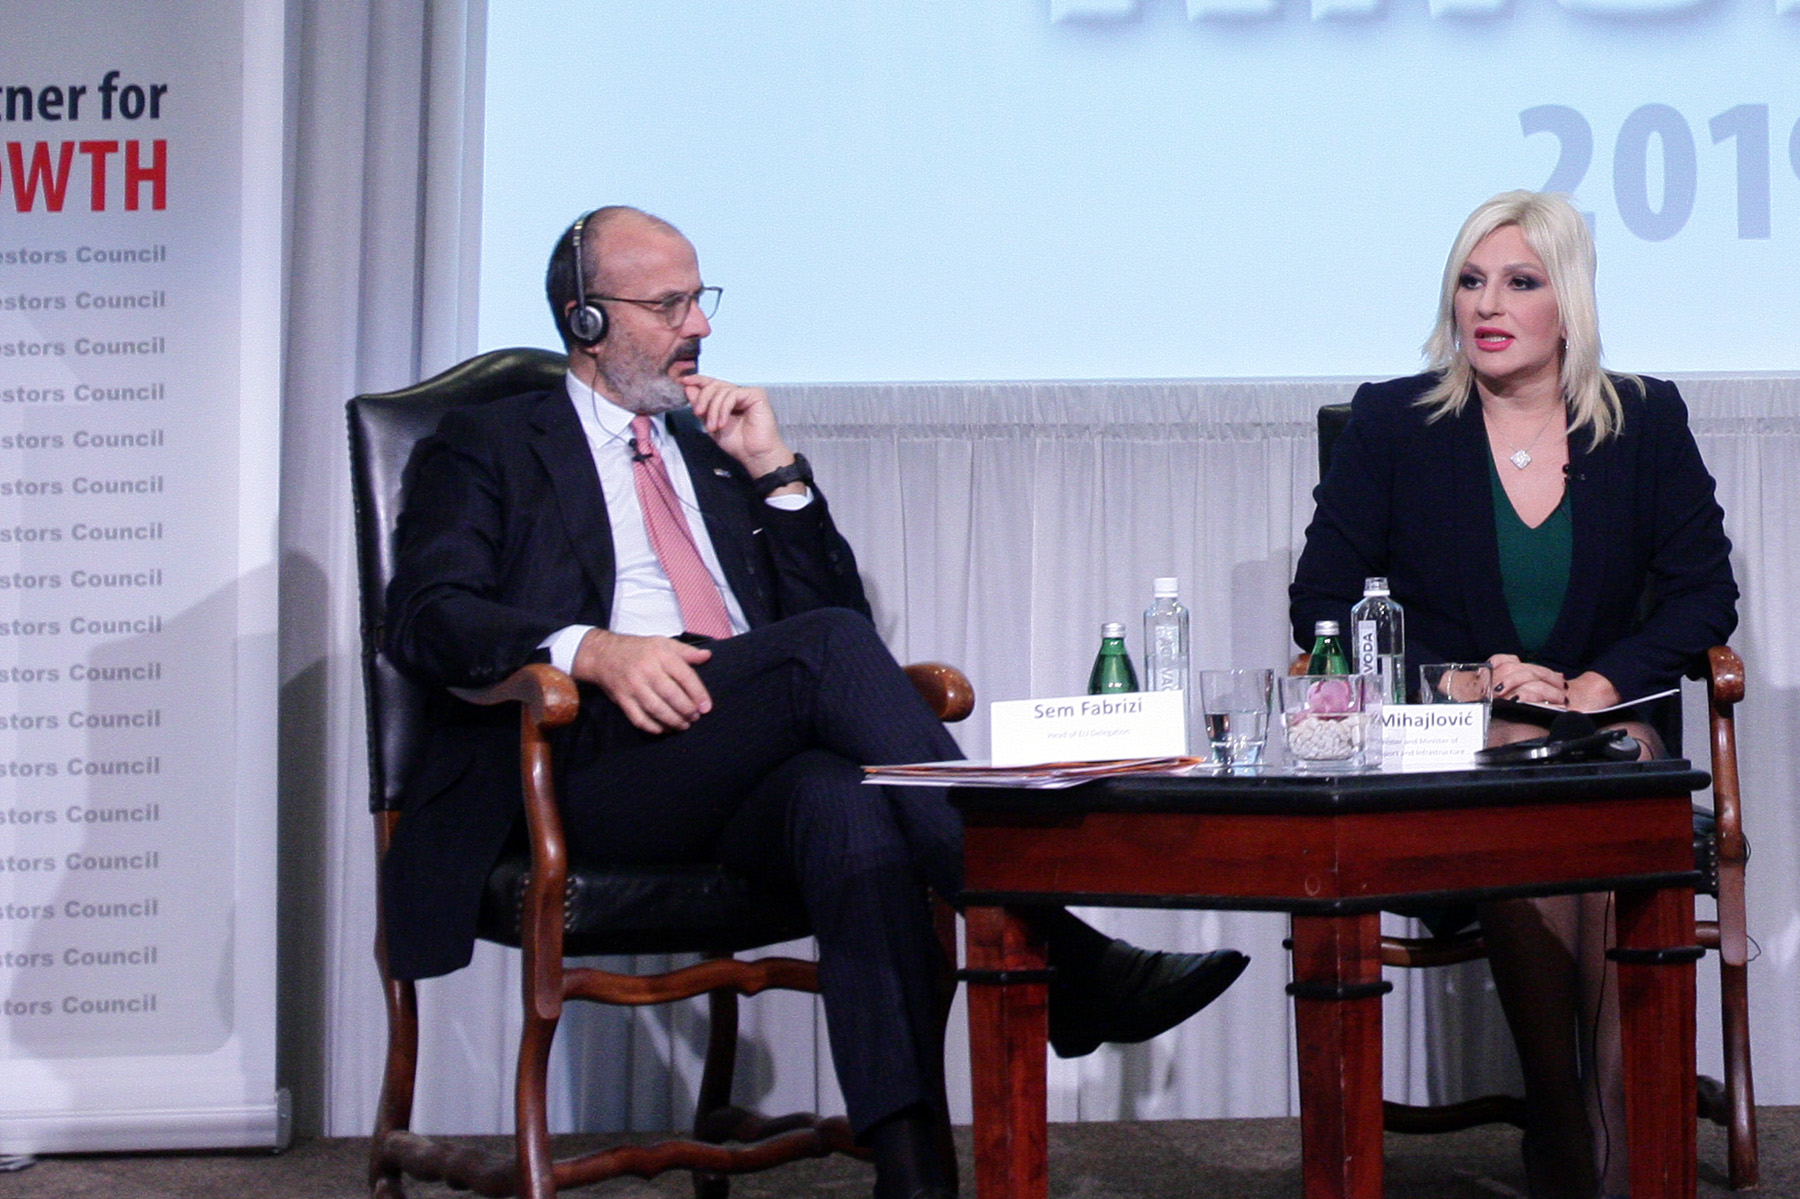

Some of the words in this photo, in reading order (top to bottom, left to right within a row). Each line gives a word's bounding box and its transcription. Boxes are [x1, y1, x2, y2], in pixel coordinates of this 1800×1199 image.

[0, 84, 87, 122] ner
[97, 69, 168, 121] for
[0, 139, 168, 213] WTH
[0, 248, 67, 265] stors
[76, 244, 166, 264] Council
[75, 290, 166, 310] Council
[74, 336, 165, 355] Council
[73, 382, 165, 402] Council
[73, 429, 164, 448] Council
[72, 475, 163, 494] Council
[71, 522, 163, 541] Council
[70, 568, 162, 588] Council
[69, 615, 162, 634] Council
[1362, 632, 1374, 673] VODA
[69, 662, 161, 681] Council
[1033, 703, 1075, 719] Sem
[1081, 697, 1143, 716] Fabrizi
[68, 709, 161, 728] Council
[1381, 711, 1474, 730] Mihajlović
[67, 756, 160, 775] Council
[66, 803, 160, 823] Council
[65, 850, 159, 871] Council
[64, 898, 158, 919] Council
[63, 946, 158, 966] Council
[62, 993, 157, 1014] Council
